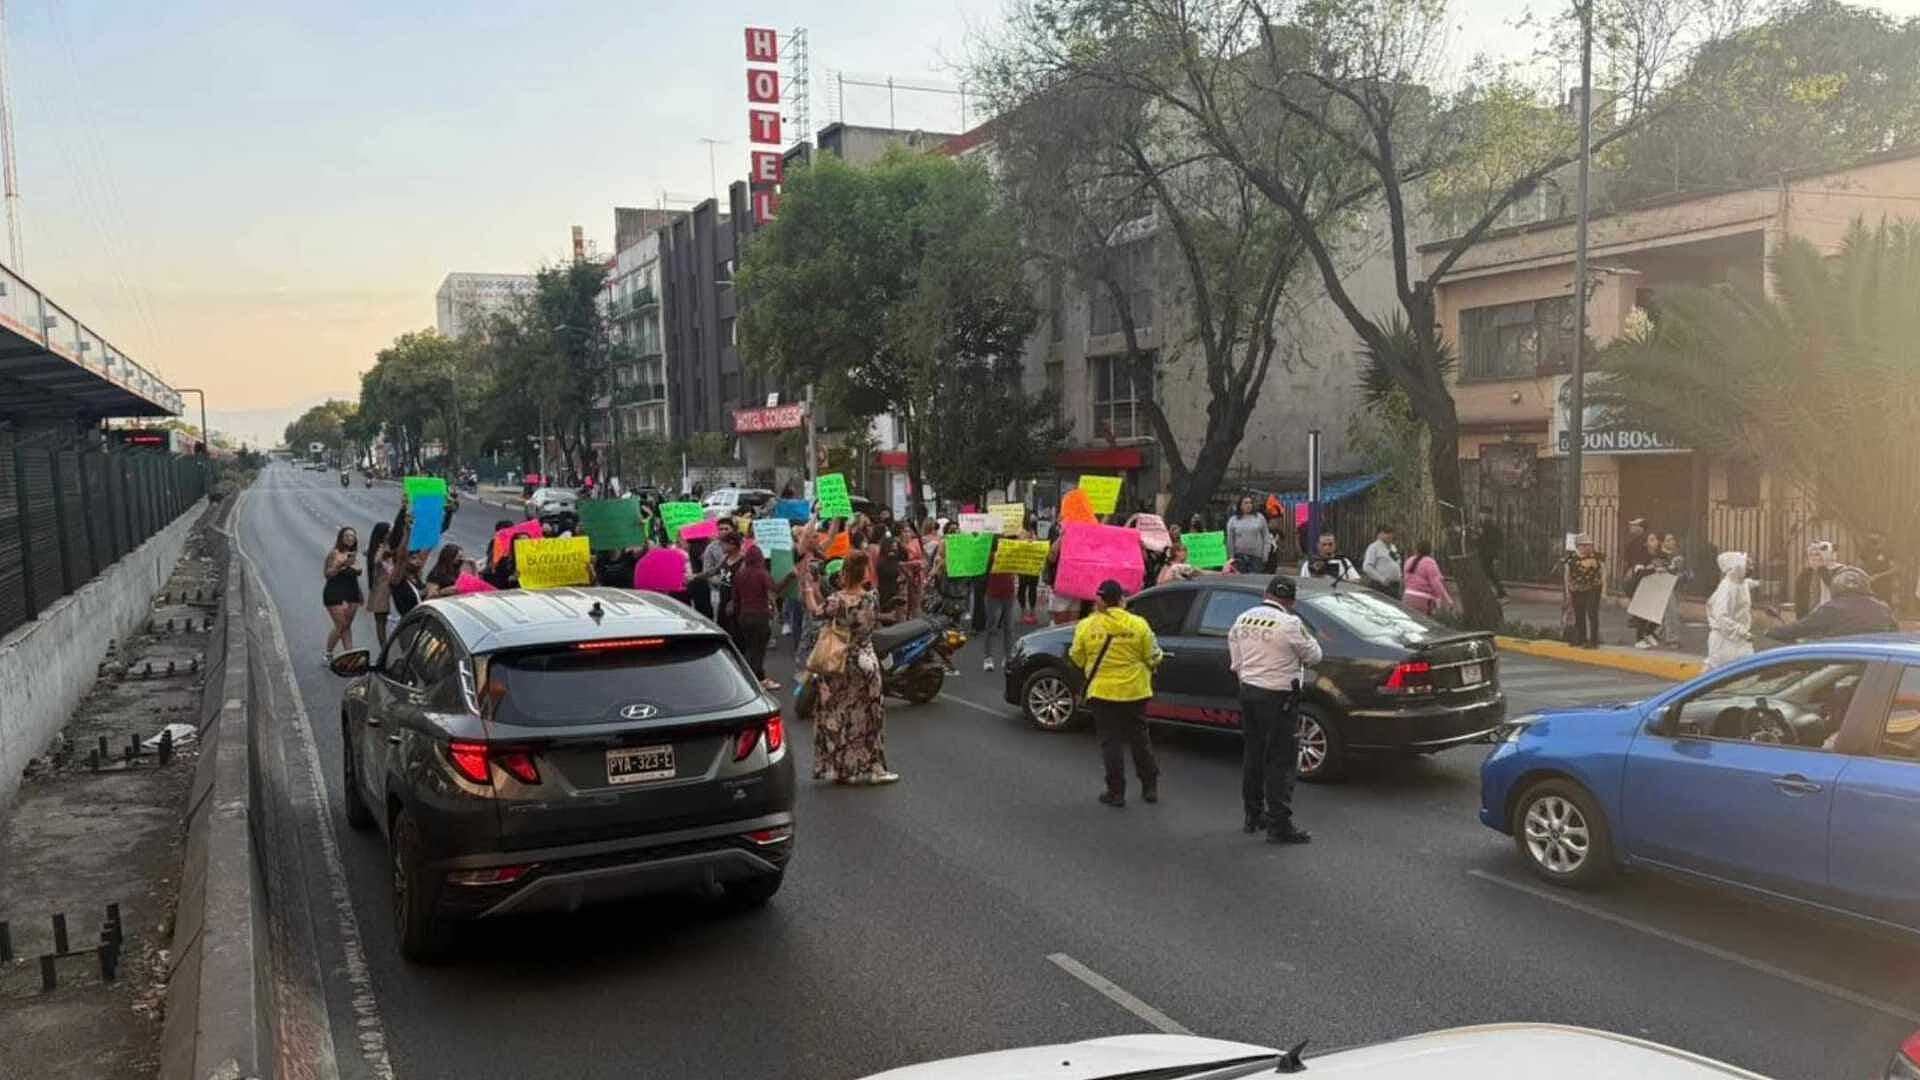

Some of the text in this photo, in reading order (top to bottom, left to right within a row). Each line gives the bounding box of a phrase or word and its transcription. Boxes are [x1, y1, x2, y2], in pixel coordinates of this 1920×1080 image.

[754, 31, 777, 220] HOTEL
[737, 410, 762, 431] HOTEL
[609, 752, 673, 773] PYA-323-E
